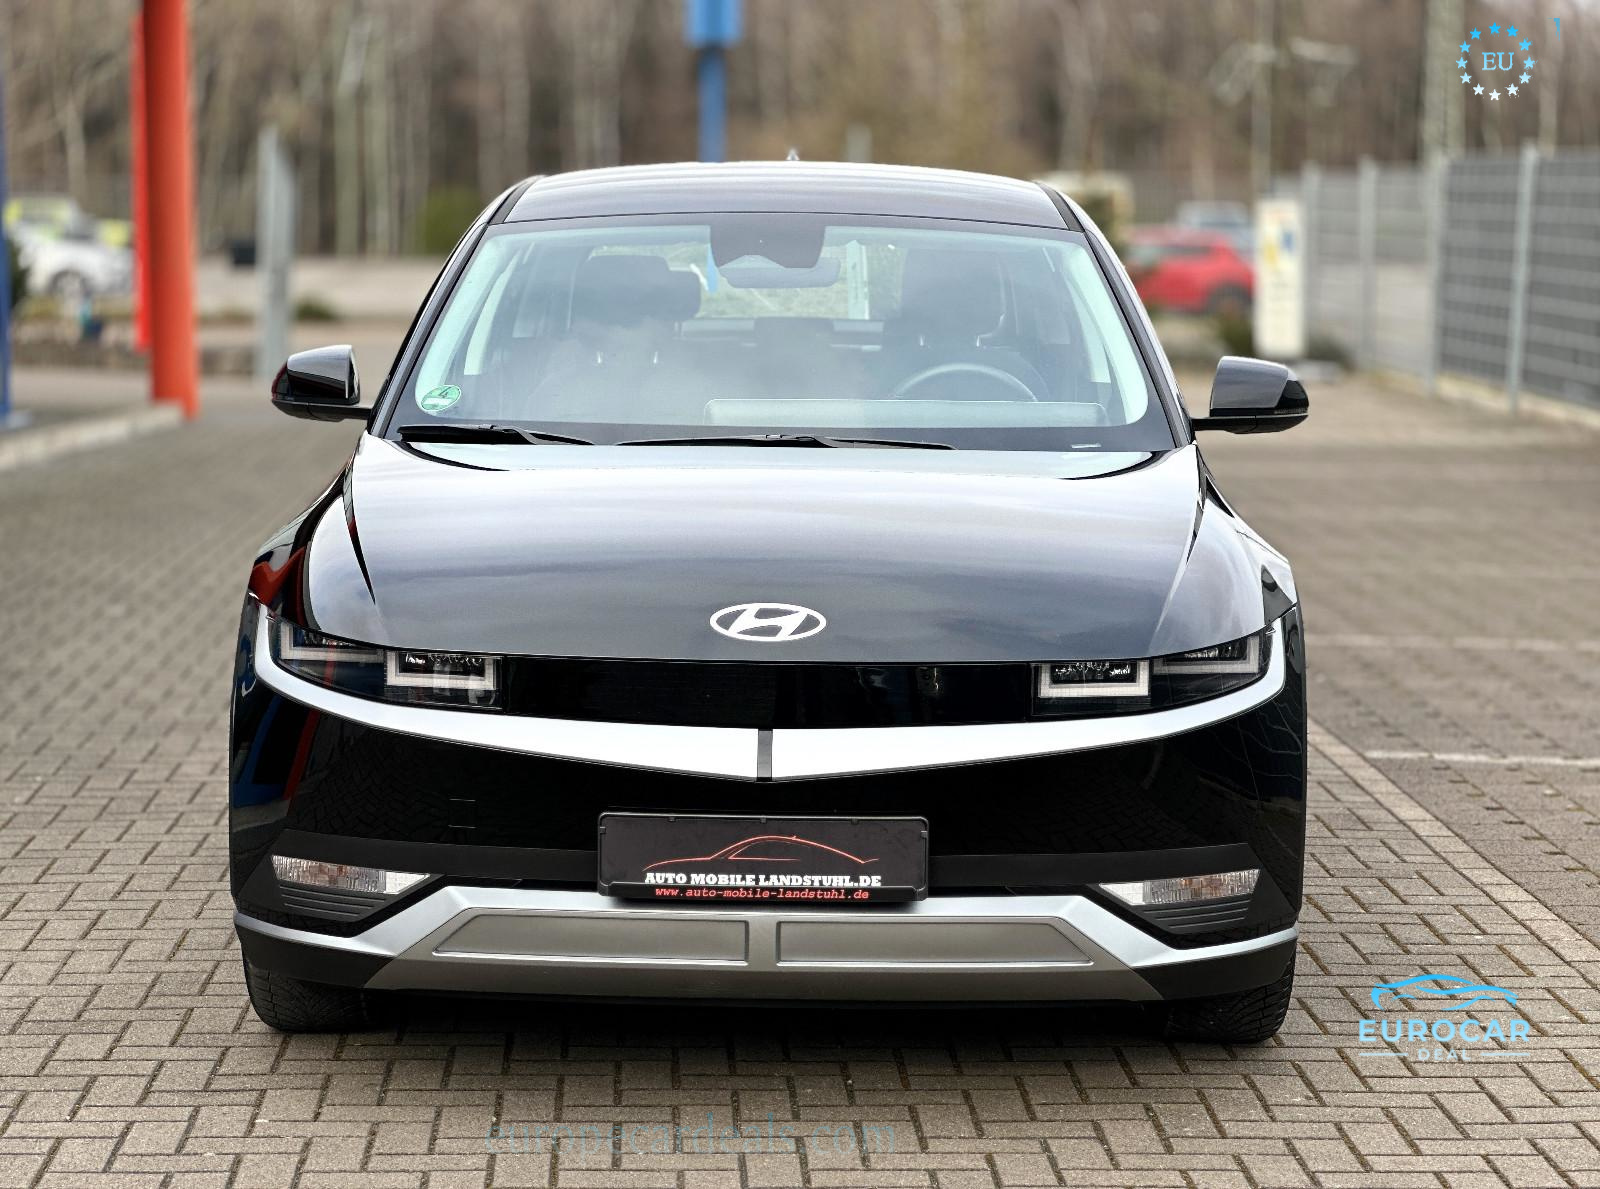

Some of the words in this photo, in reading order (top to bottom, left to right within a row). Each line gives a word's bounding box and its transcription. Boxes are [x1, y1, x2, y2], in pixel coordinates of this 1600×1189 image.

[645, 872, 687, 884] AUTO
[690, 873, 755, 885] MOBILE
[758, 874, 881, 887] LANDSTUHL.DE
[655, 887, 869, 899] www.auto-mobile-landstuhl.de
